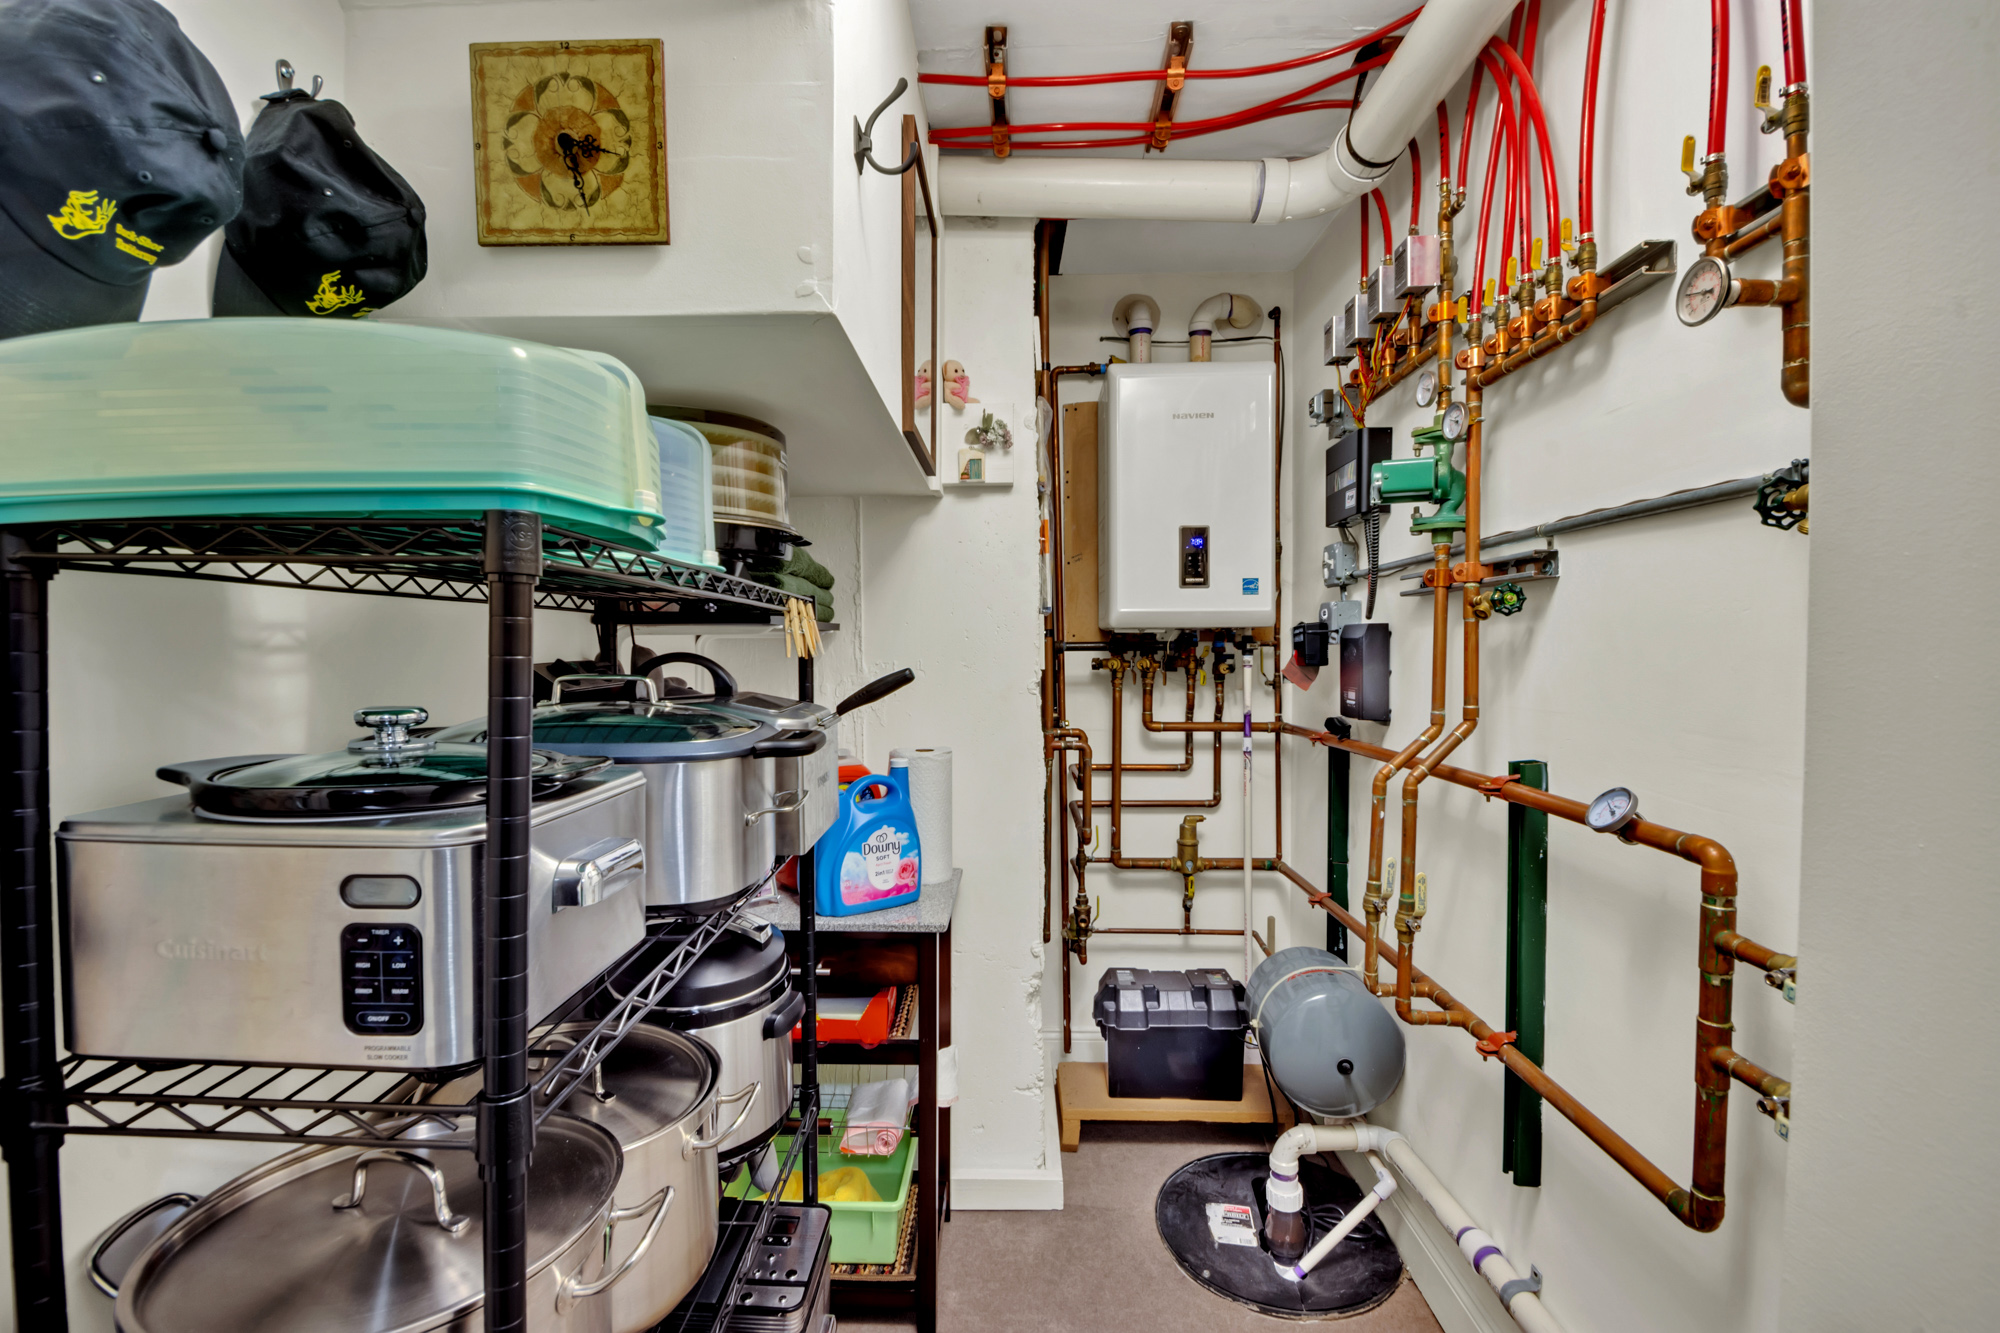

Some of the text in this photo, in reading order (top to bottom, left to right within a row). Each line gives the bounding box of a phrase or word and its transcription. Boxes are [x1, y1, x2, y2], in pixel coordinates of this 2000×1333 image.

[657, 141, 663, 149] 3
[863, 841, 901, 856] Downy
[154, 937, 267, 960] Cuisinart
